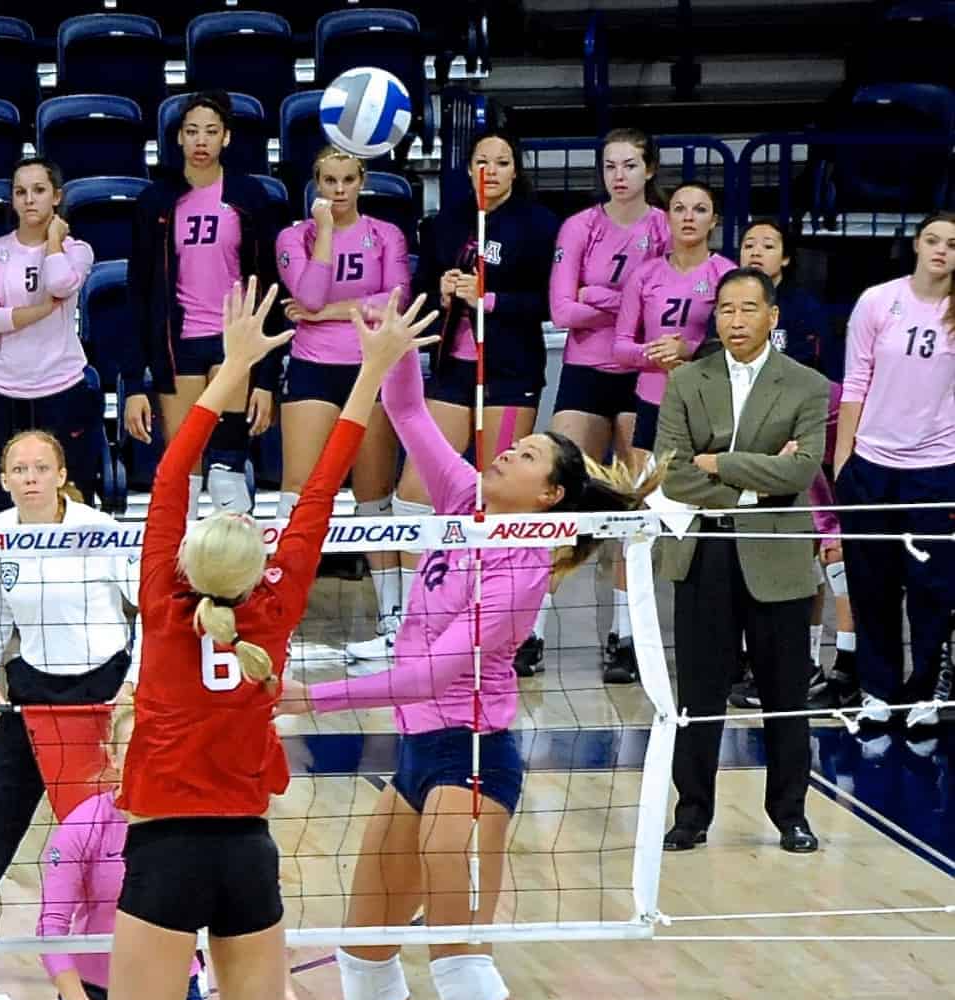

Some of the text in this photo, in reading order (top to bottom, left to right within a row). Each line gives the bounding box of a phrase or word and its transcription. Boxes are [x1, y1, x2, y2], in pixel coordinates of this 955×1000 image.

[183, 215, 219, 246] 33
[25, 266, 39, 293] 5
[335, 253, 364, 282] 15
[610, 254, 628, 284] 7
[660, 298, 693, 328] 21
[906, 326, 937, 359] 13
[441, 521, 468, 544] A
[201, 634, 242, 691] 6
